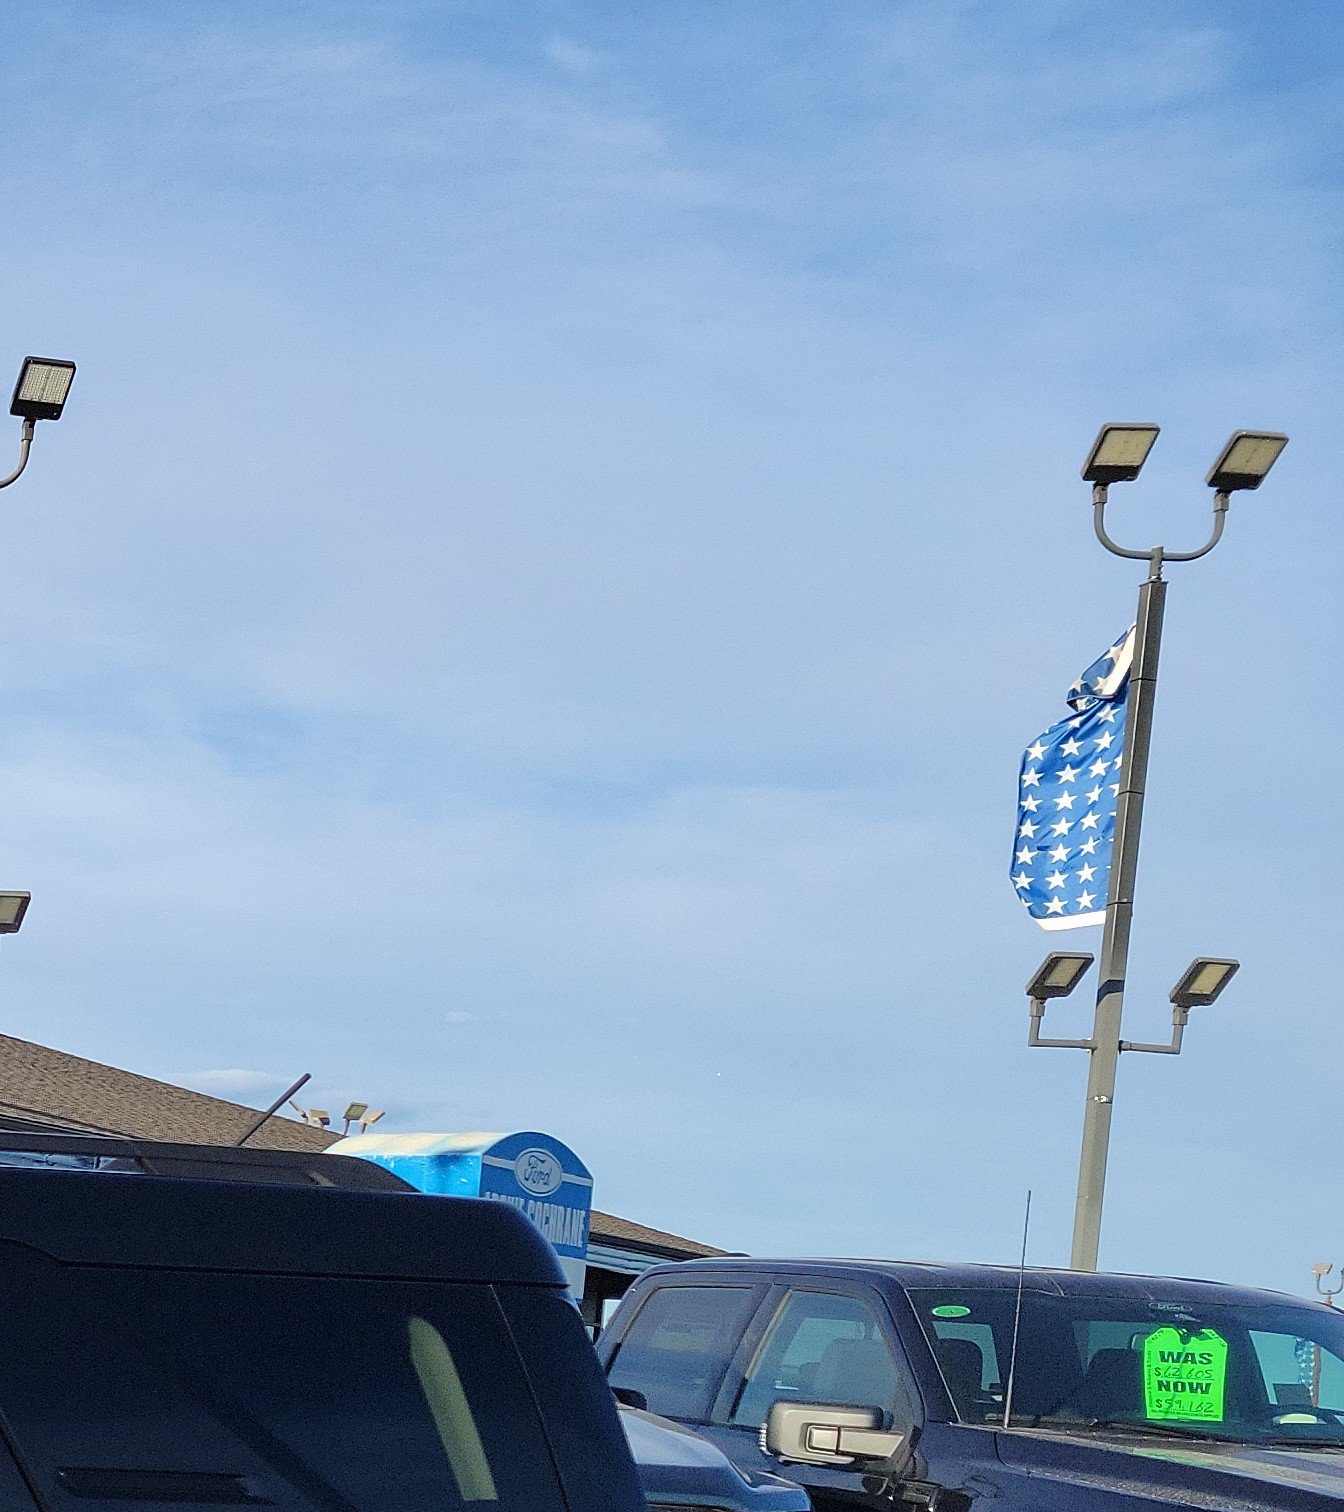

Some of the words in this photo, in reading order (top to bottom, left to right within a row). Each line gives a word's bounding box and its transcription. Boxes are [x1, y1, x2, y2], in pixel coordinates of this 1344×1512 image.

[524, 1154, 553, 1187] Ford
[1159, 1351, 1213, 1364] WAS
[1157, 1380, 1212, 1394] NOW
